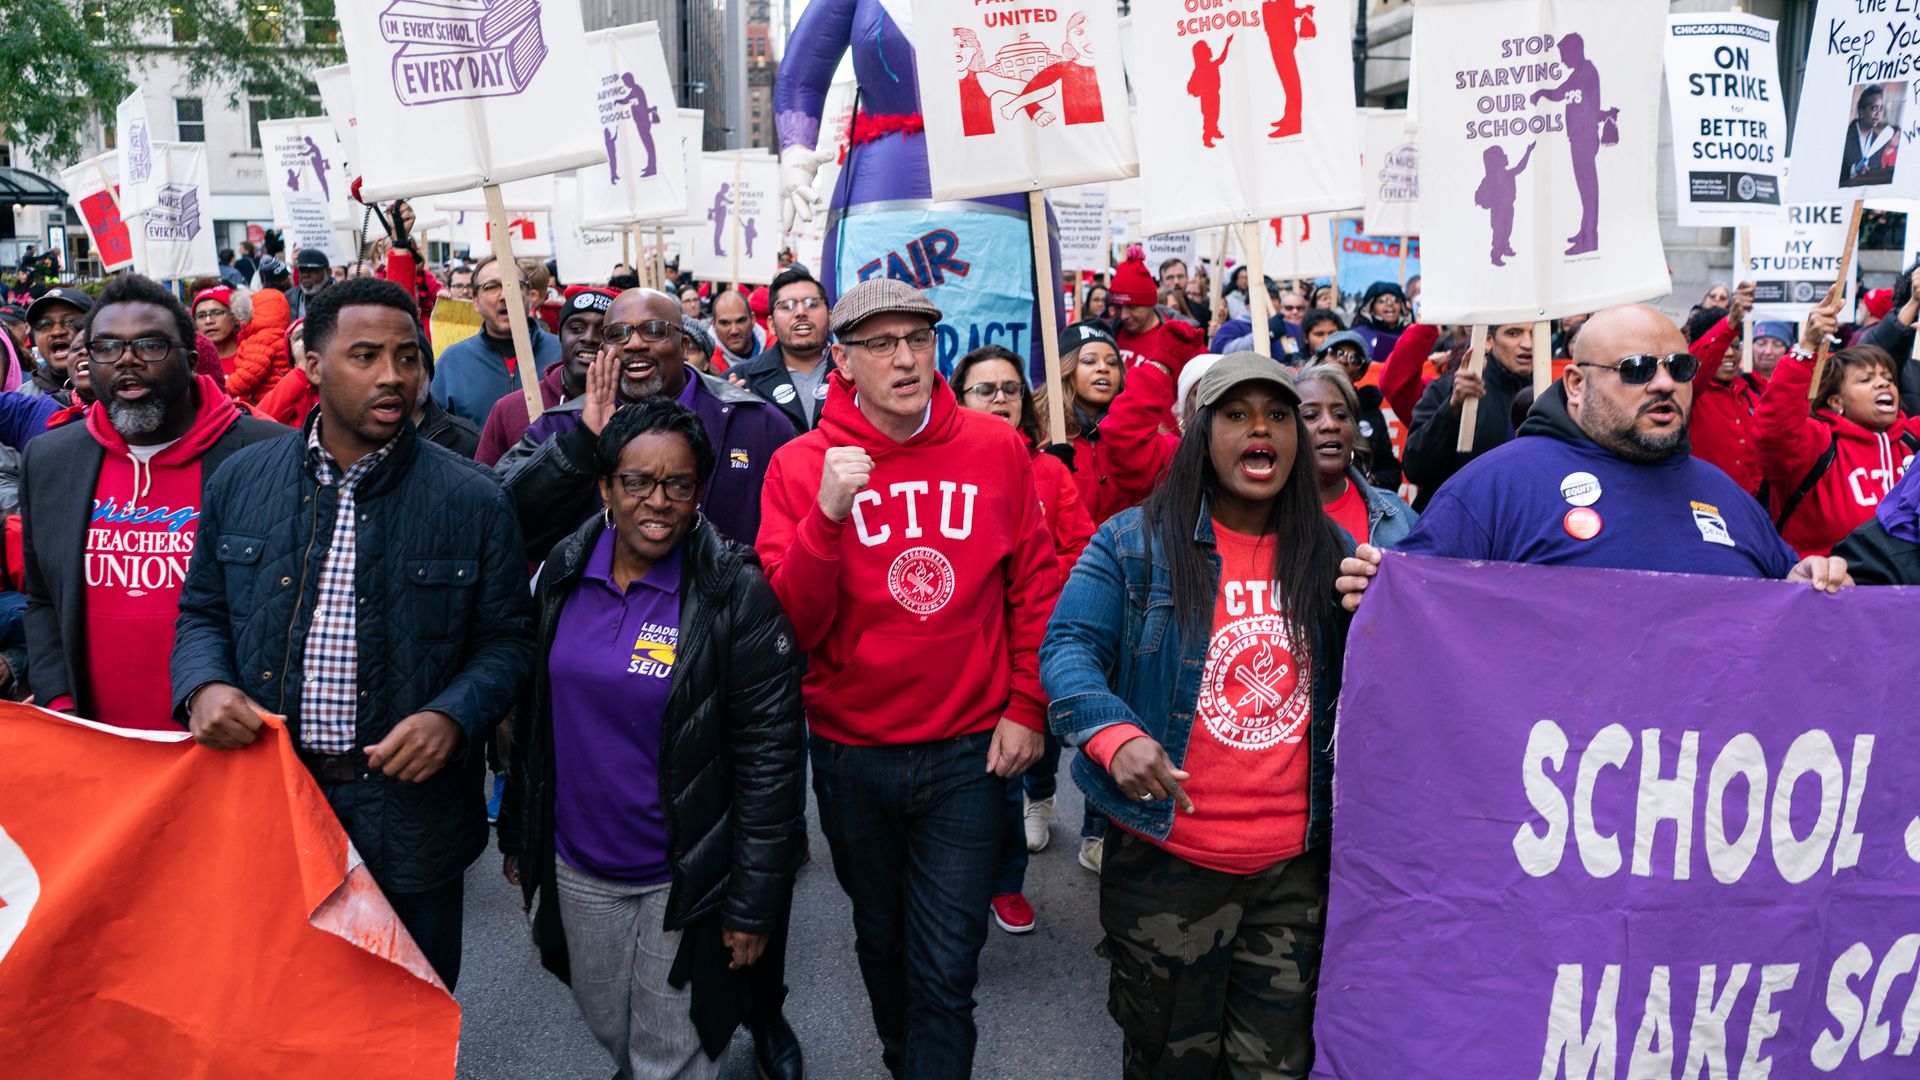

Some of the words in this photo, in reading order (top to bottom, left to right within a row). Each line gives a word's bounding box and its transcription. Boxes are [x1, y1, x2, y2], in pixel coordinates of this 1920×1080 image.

[984, 8, 1057, 28] UNITED
[1177, 10, 1260, 36] SCHOOLS
[385, 20, 399, 34] IN
[402, 21, 435, 39] EVERY
[436, 22, 475, 43] SCHOOL
[1673, 25, 1718, 34] CHICAGO
[1718, 24, 1745, 35] PUBLIC
[1745, 27, 1770, 42] SCHOOLS
[1828, 18, 1875, 56] Keep
[1501, 34, 1555, 58] STOP
[1714, 45, 1749, 71] ON
[402, 57, 465, 95] EVERY
[466, 51, 504, 89] DAY
[602, 73, 620, 86] STOP
[1455, 62, 1563, 90] STARVING
[597, 86, 626, 100] ARVING
[1689, 73, 1769, 102] STRIKE
[599, 102, 613, 113] OUR
[1477, 93, 1526, 114] OUR
[1731, 105, 1744, 113] for
[600, 110, 632, 124] CHOOLS
[1466, 114, 1564, 139] SCHOOLS
[1700, 118, 1767, 139] BETTER
[1693, 142, 1774, 163] SCHOOLS
[158, 194, 181, 210] NURSE
[1788, 206, 1843, 224] RIKE
[149, 225, 173, 238] EVERY
[175, 225, 187, 238] DAY
[582, 232, 615, 245] School
[1150, 245, 1187, 253] United!
[1785, 240, 1813, 254] MY
[1750, 257, 1844, 270] STUDENTS
[936, 322, 1028, 382] RACT
[731, 461, 749, 469] SEIU
[1564, 480, 1598, 498] EQUITY
[1848, 466, 1905, 507] CT
[91, 496, 201, 532] hicag
[851, 480, 978, 547] CTU
[86, 528, 195, 553] TEACHERS
[84, 553, 193, 589] UNION
[638, 631, 667, 644] LOCAL
[627, 659, 672, 679] SEIU
[1200, 636, 1230, 709] CHICAGO
[1230, 619, 1292, 638] TEACH
[1215, 635, 1259, 692] ORGANIZE
[1211, 716, 1241, 740] AFT
[1242, 721, 1290, 744] LOCAL
[1287, 710, 1298, 721] 1
[1242, 716, 1270, 728] 1937
[1512, 719, 1876, 885] SCHOOL
[1537, 961, 1801, 1080] MAKE
[1809, 932, 1920, 1073] SC
